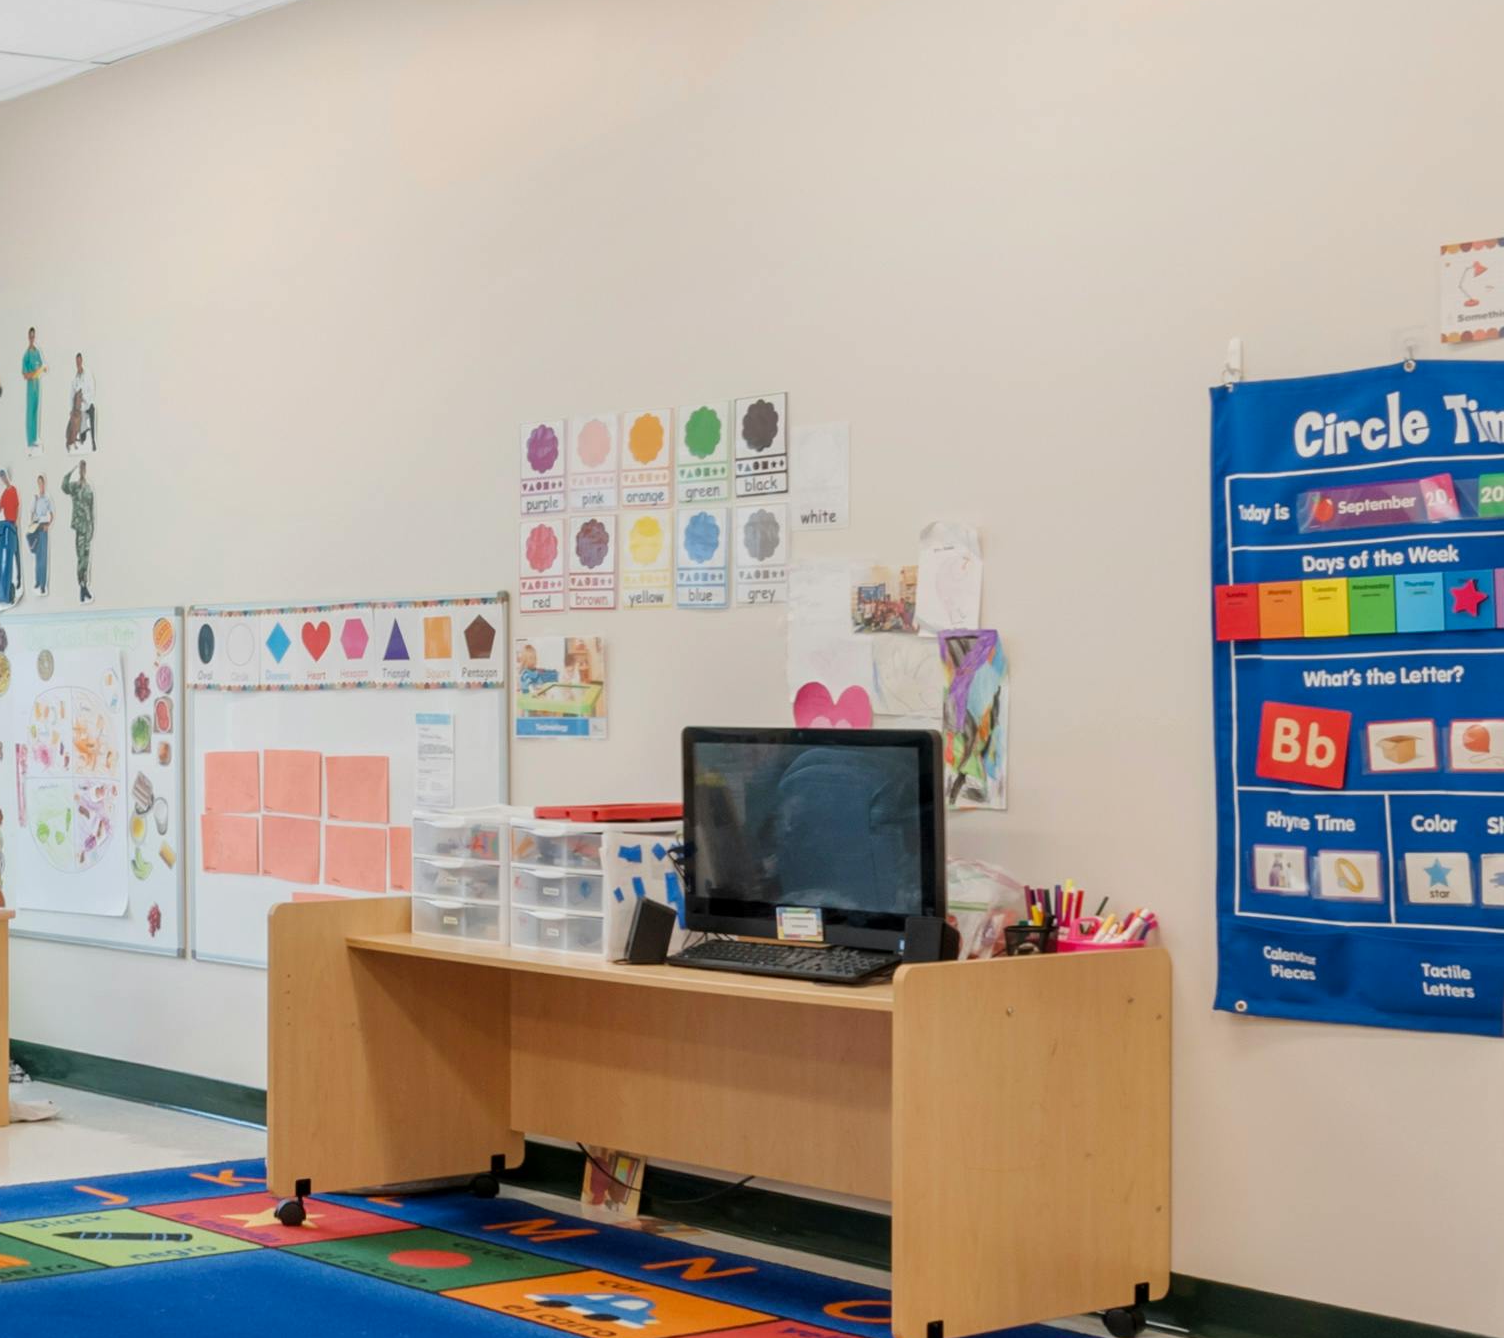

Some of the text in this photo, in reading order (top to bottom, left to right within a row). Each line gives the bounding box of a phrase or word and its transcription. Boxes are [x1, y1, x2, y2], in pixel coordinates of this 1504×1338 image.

[1294, 391, 1430, 459] Circle
[685, 485, 721, 499] green
[743, 477, 778, 493] black
[525, 497, 559, 513] purple
[581, 492, 605, 508] pink
[625, 490, 665, 507] orange
[799, 509, 837, 526] white
[1238, 504, 1271, 525] Today
[1273, 503, 1290, 521] is
[1337, 494, 1416, 517] September
[1302, 543, 1460, 575] Days of the Week
[1403, 580, 1435, 589] Thursday
[532, 595, 552, 610] red
[575, 593, 609, 607] brown
[627, 590, 665, 606] yellow
[688, 588, 714, 603] blue
[747, 587, 777, 604] grey
[197, 670, 214, 681] Oval
[306, 670, 327, 681] Heart
[381, 667, 411, 679] Triangle
[461, 666, 498, 679] Pentagon
[1302, 665, 1465, 688] What's the Letter?
[1270, 716, 1338, 769] Bb
[1313, 813, 1357, 832] Time
[1410, 814, 1459, 833] Color
[1429, 888, 1451, 900] star
[1270, 963, 1317, 981] Pieces
[1420, 962, 1472, 980] Tactile
[1422, 981, 1475, 999] Letters
